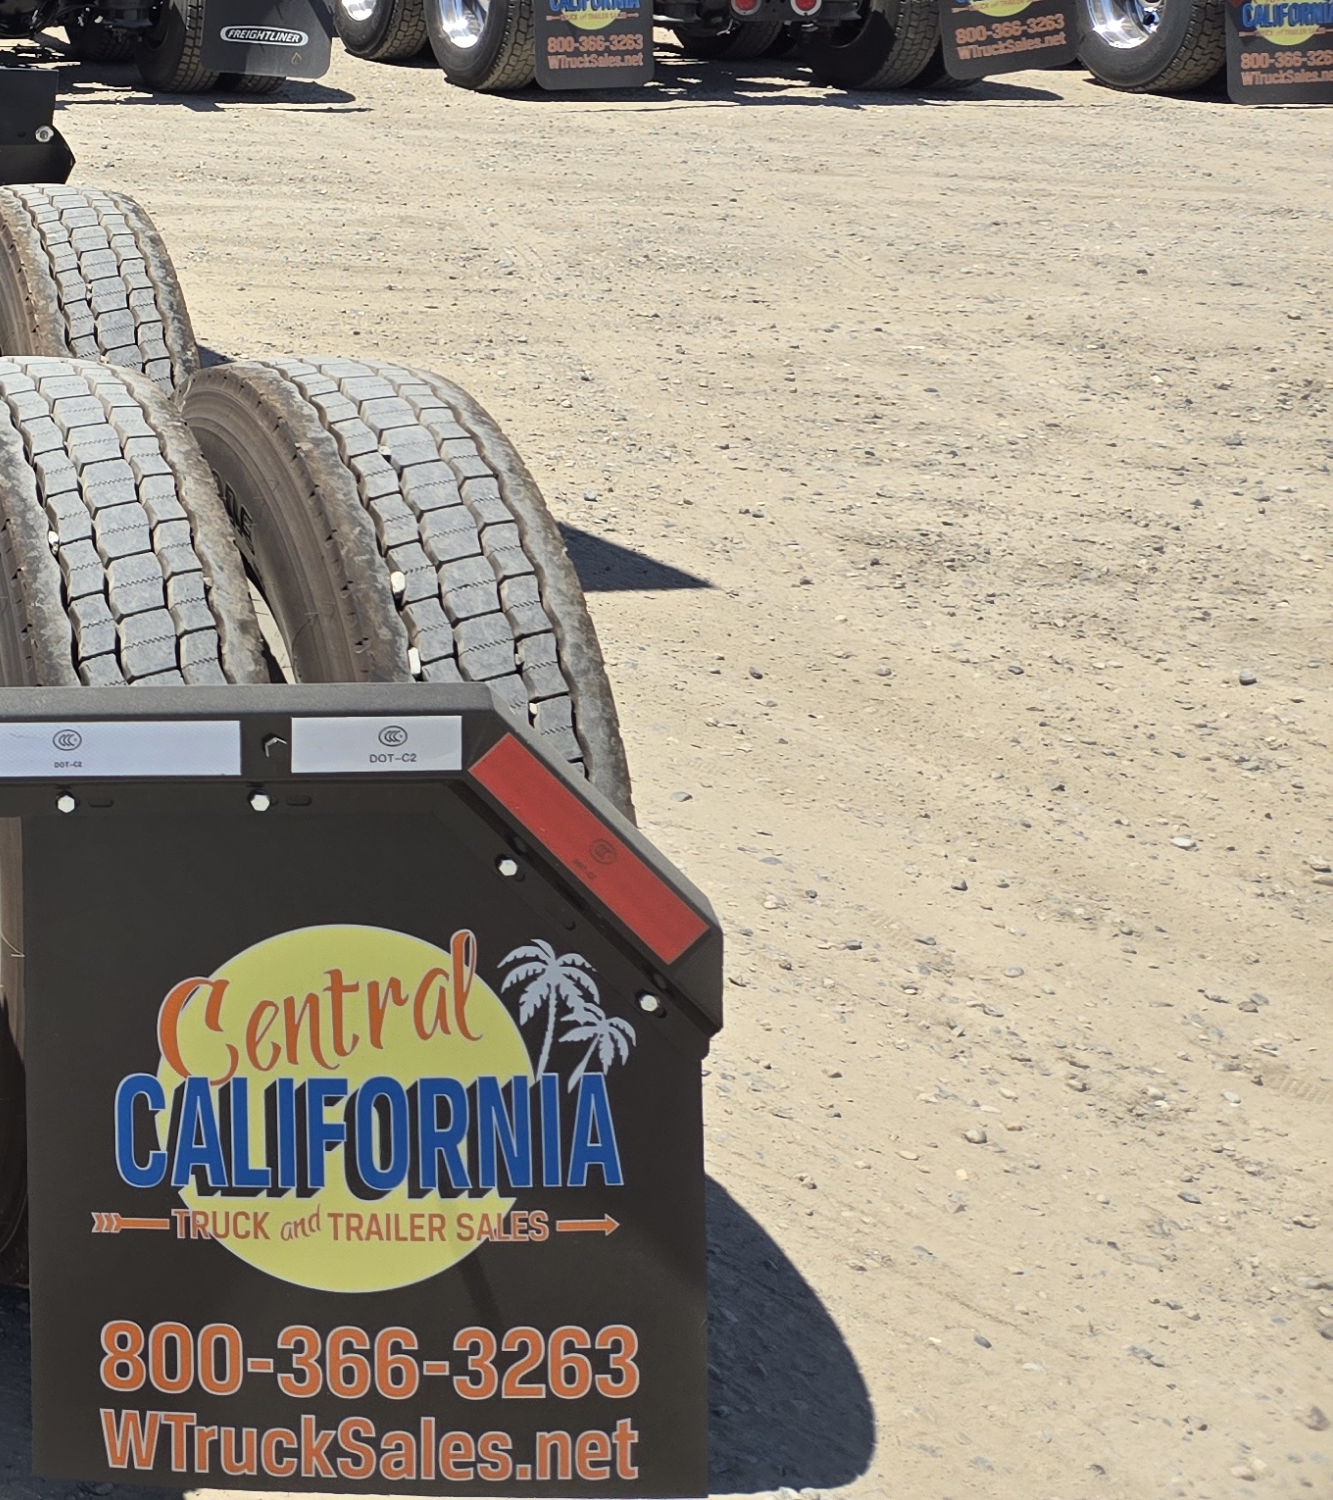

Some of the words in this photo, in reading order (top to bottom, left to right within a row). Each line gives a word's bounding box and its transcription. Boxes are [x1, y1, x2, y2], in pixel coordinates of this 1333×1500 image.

[228, 29, 300, 42] FREIGHTLINER
[955, 13, 1065, 44] 800-366-3263
[547, 34, 644, 53] 800-366-3263
[957, 31, 1067, 60] WTruckSales.net
[547, 52, 644, 69] WTruckSales.net
[1241, 50, 1333, 69] 800-366-326
[1241, 69, 1333, 86] WTruckSales.n
[369, 752, 417, 763] DOT-C2
[157, 929, 484, 1087] Central
[113, 1070, 624, 1190] CALIFORNIA
[172, 1208, 270, 1240] TRUCK
[279, 1201, 323, 1242] and
[330, 1211, 446, 1243] TRAILER
[455, 1209, 550, 1243] SALES
[99, 1318, 641, 1399] 800-366-3263
[99, 1408, 640, 1481] WTruckSales.net
